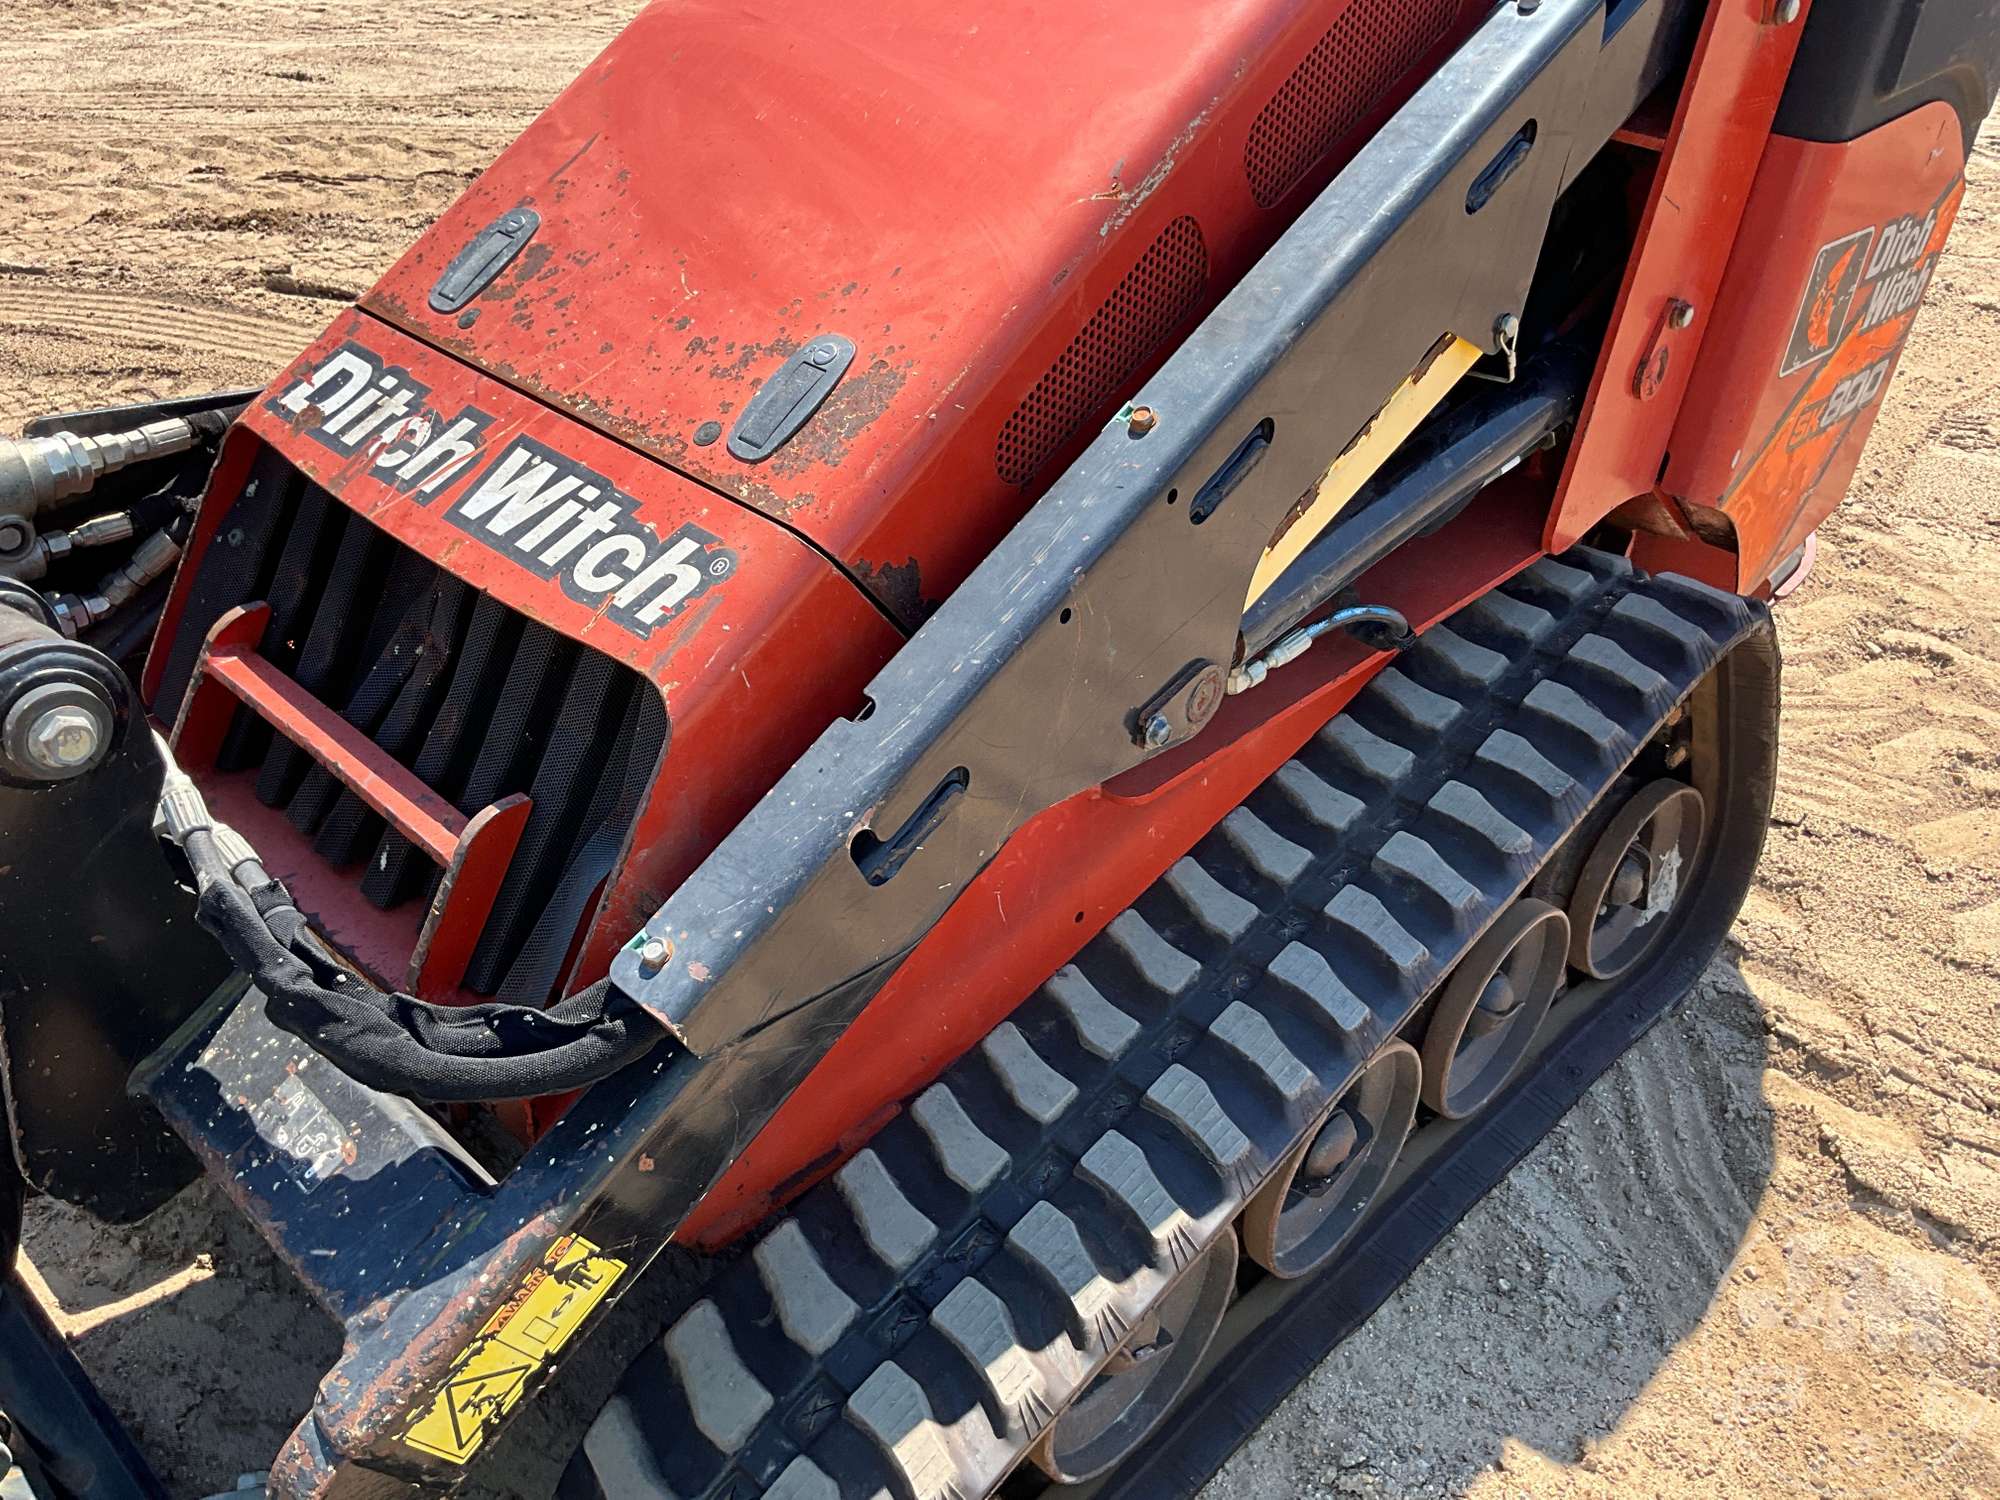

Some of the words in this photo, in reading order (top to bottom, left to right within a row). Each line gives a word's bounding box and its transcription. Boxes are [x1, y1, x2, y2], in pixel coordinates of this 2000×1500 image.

[1865, 208, 1935, 280] Ditch
[1860, 258, 1931, 330] Witch
[277, 350, 477, 494] Ditch
[1820, 359, 1889, 428] 800
